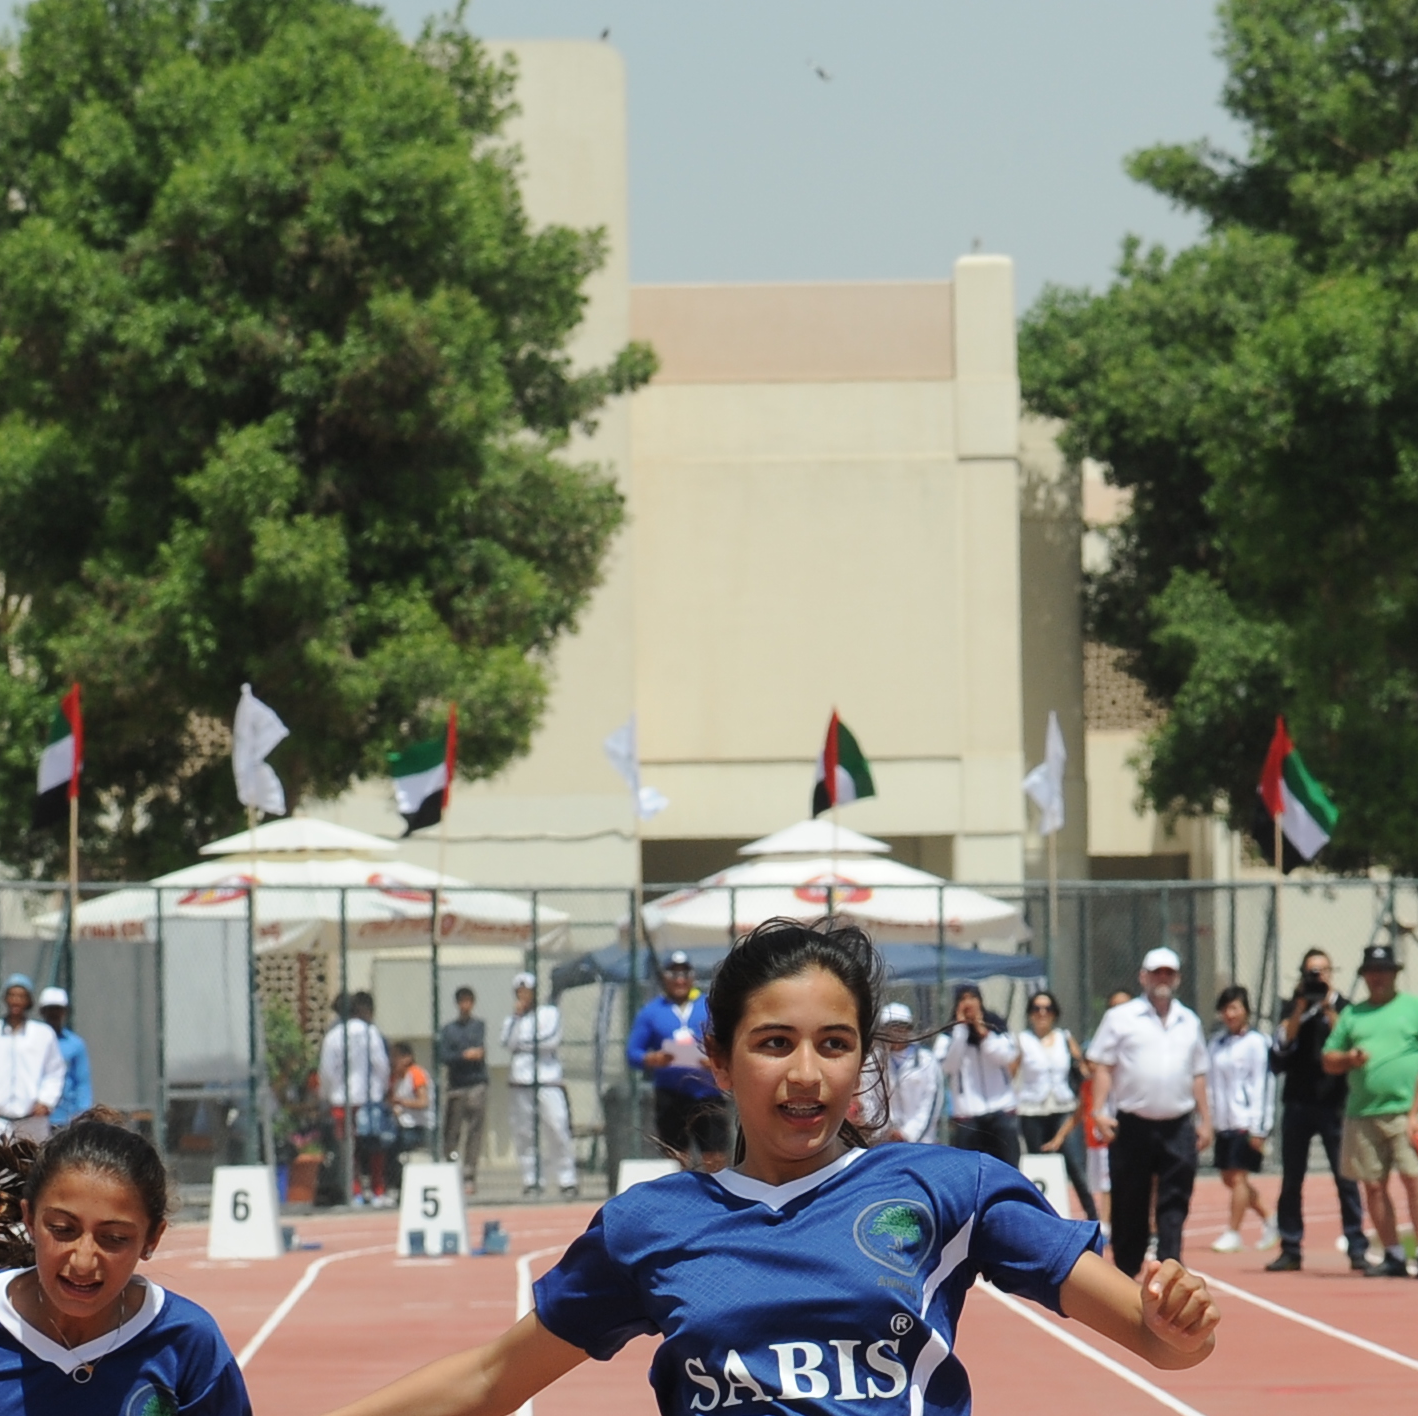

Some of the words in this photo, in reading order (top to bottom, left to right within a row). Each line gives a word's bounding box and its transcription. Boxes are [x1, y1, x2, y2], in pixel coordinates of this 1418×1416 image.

[232, 1190, 250, 1222] 6
[422, 1187, 440, 1218] 5
[684, 1338, 908, 1412] SABIS
